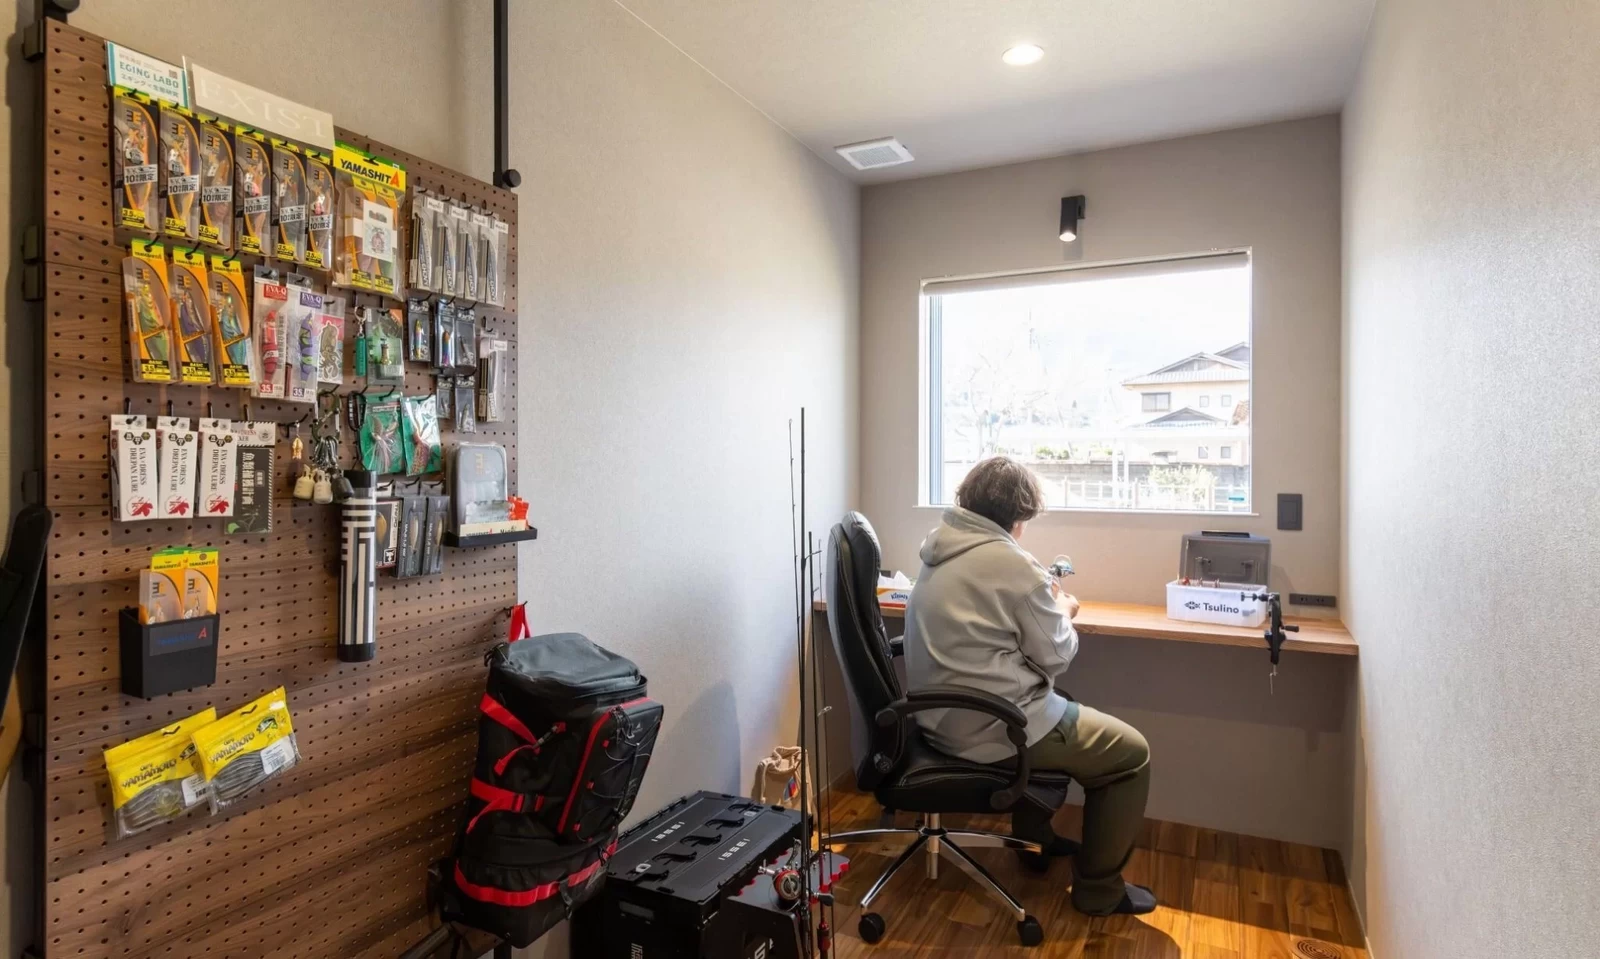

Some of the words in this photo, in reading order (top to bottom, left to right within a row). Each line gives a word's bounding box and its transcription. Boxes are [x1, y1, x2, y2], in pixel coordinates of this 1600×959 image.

[120, 61, 150, 79] EGING
[154, 73, 179, 89] LABO
[340, 158, 400, 188] YAMASHITA
[265, 285, 287, 295] EVA-Q
[301, 292, 321, 303] EVA-Q
[1203, 602, 1239, 614] Tsulino
[122, 759, 177, 788] YAMAMOTO
